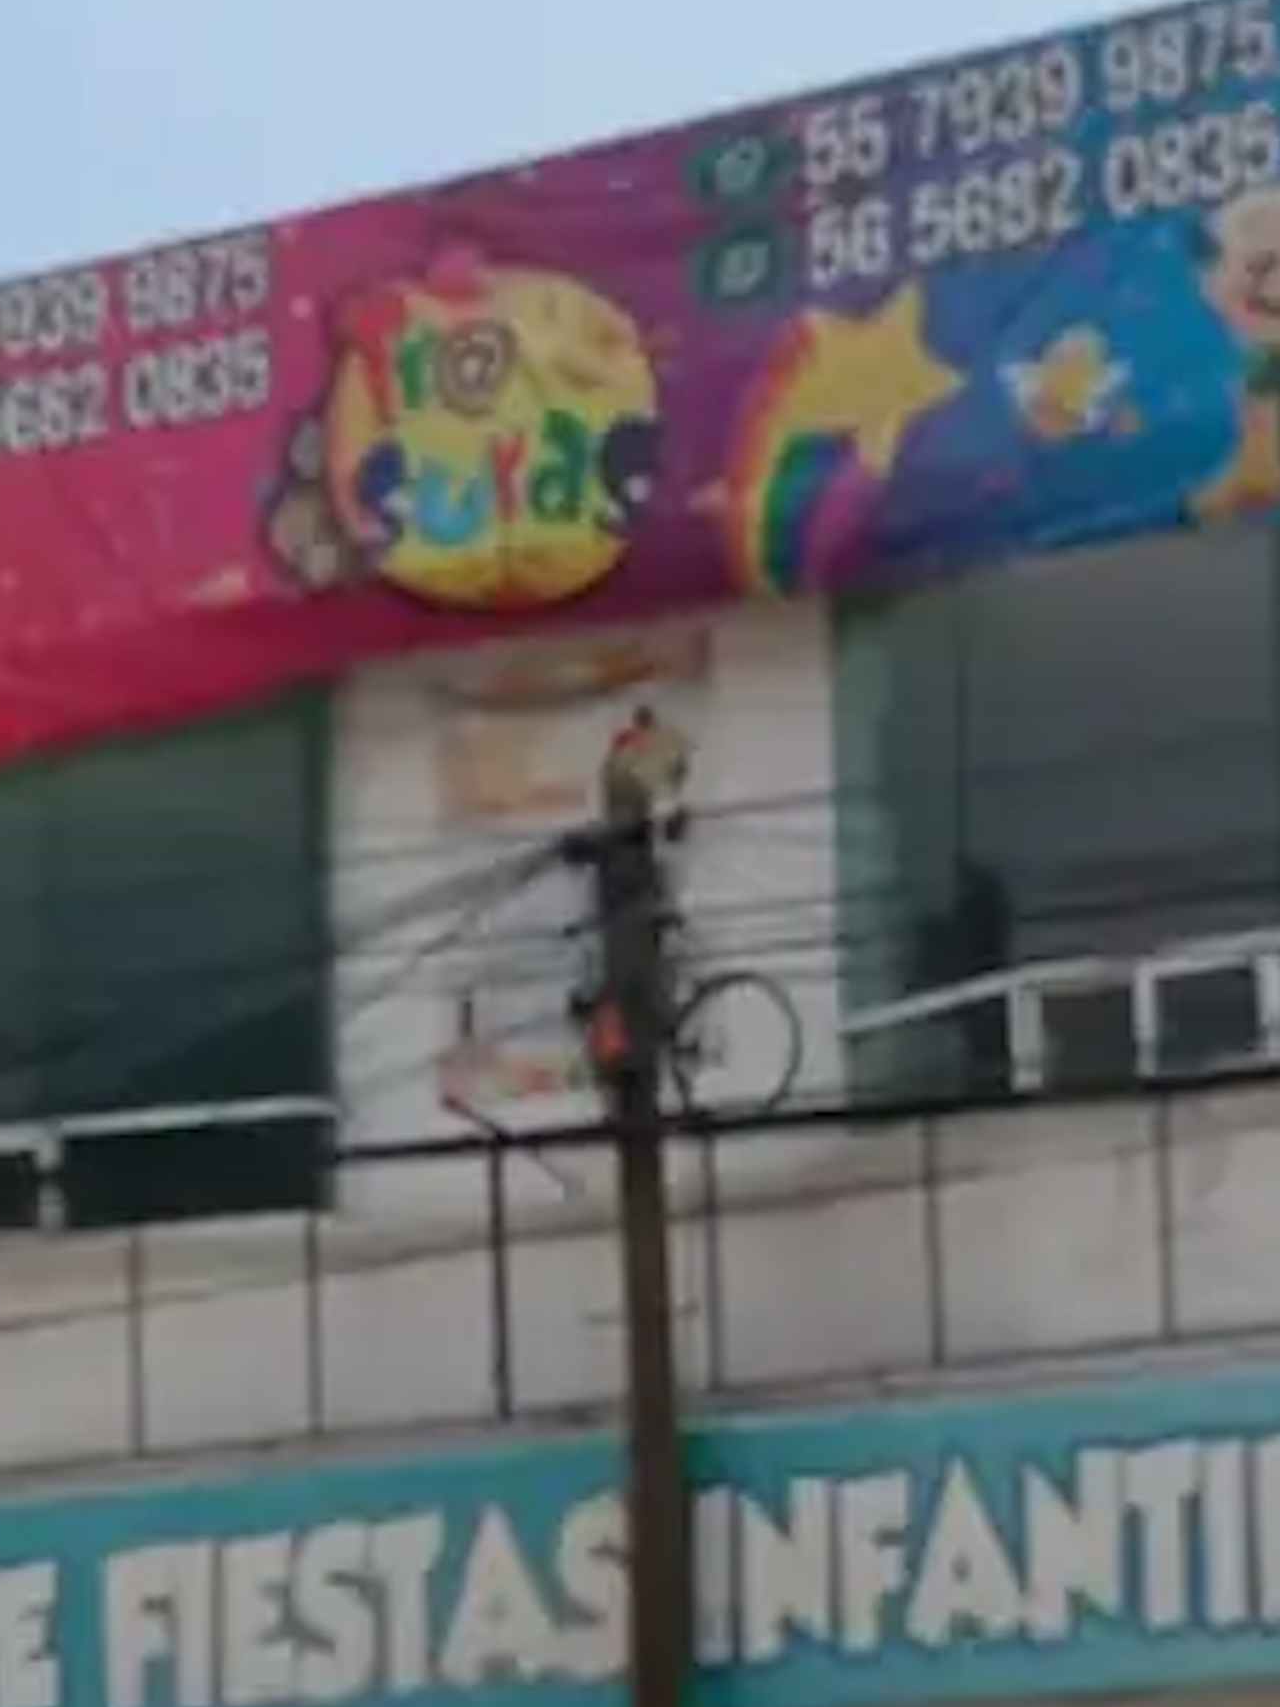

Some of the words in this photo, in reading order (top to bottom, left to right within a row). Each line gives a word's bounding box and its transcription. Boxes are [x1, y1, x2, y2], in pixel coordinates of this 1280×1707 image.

[802, 95, 892, 186] 55
[910, 47, 1081, 156] 7939
[806, 198, 892, 291] 56
